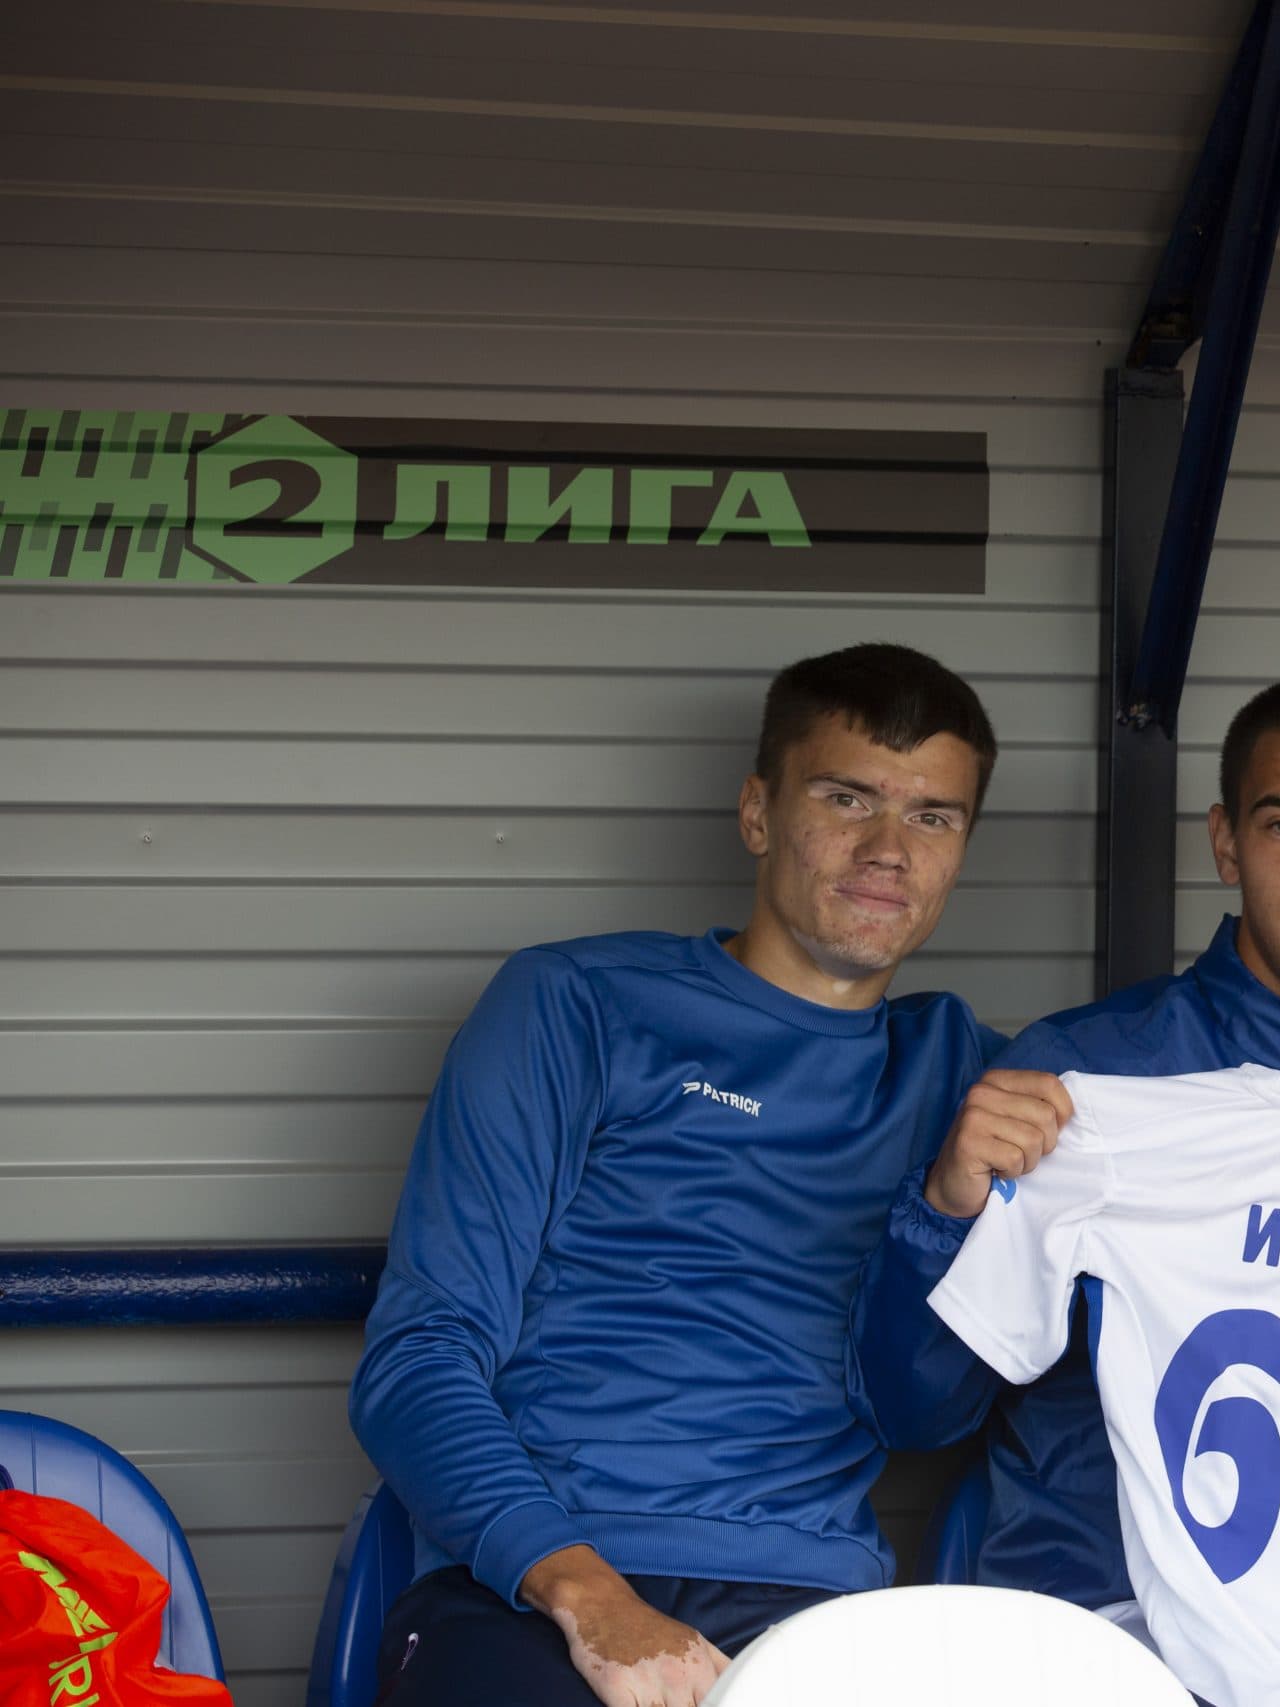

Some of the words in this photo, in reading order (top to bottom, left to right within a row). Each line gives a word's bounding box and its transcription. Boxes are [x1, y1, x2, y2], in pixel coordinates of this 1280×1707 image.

[223, 459, 325, 538] 2
[383, 464, 812, 546] ЛИГА
[702, 1081, 762, 1117] PATRICK
